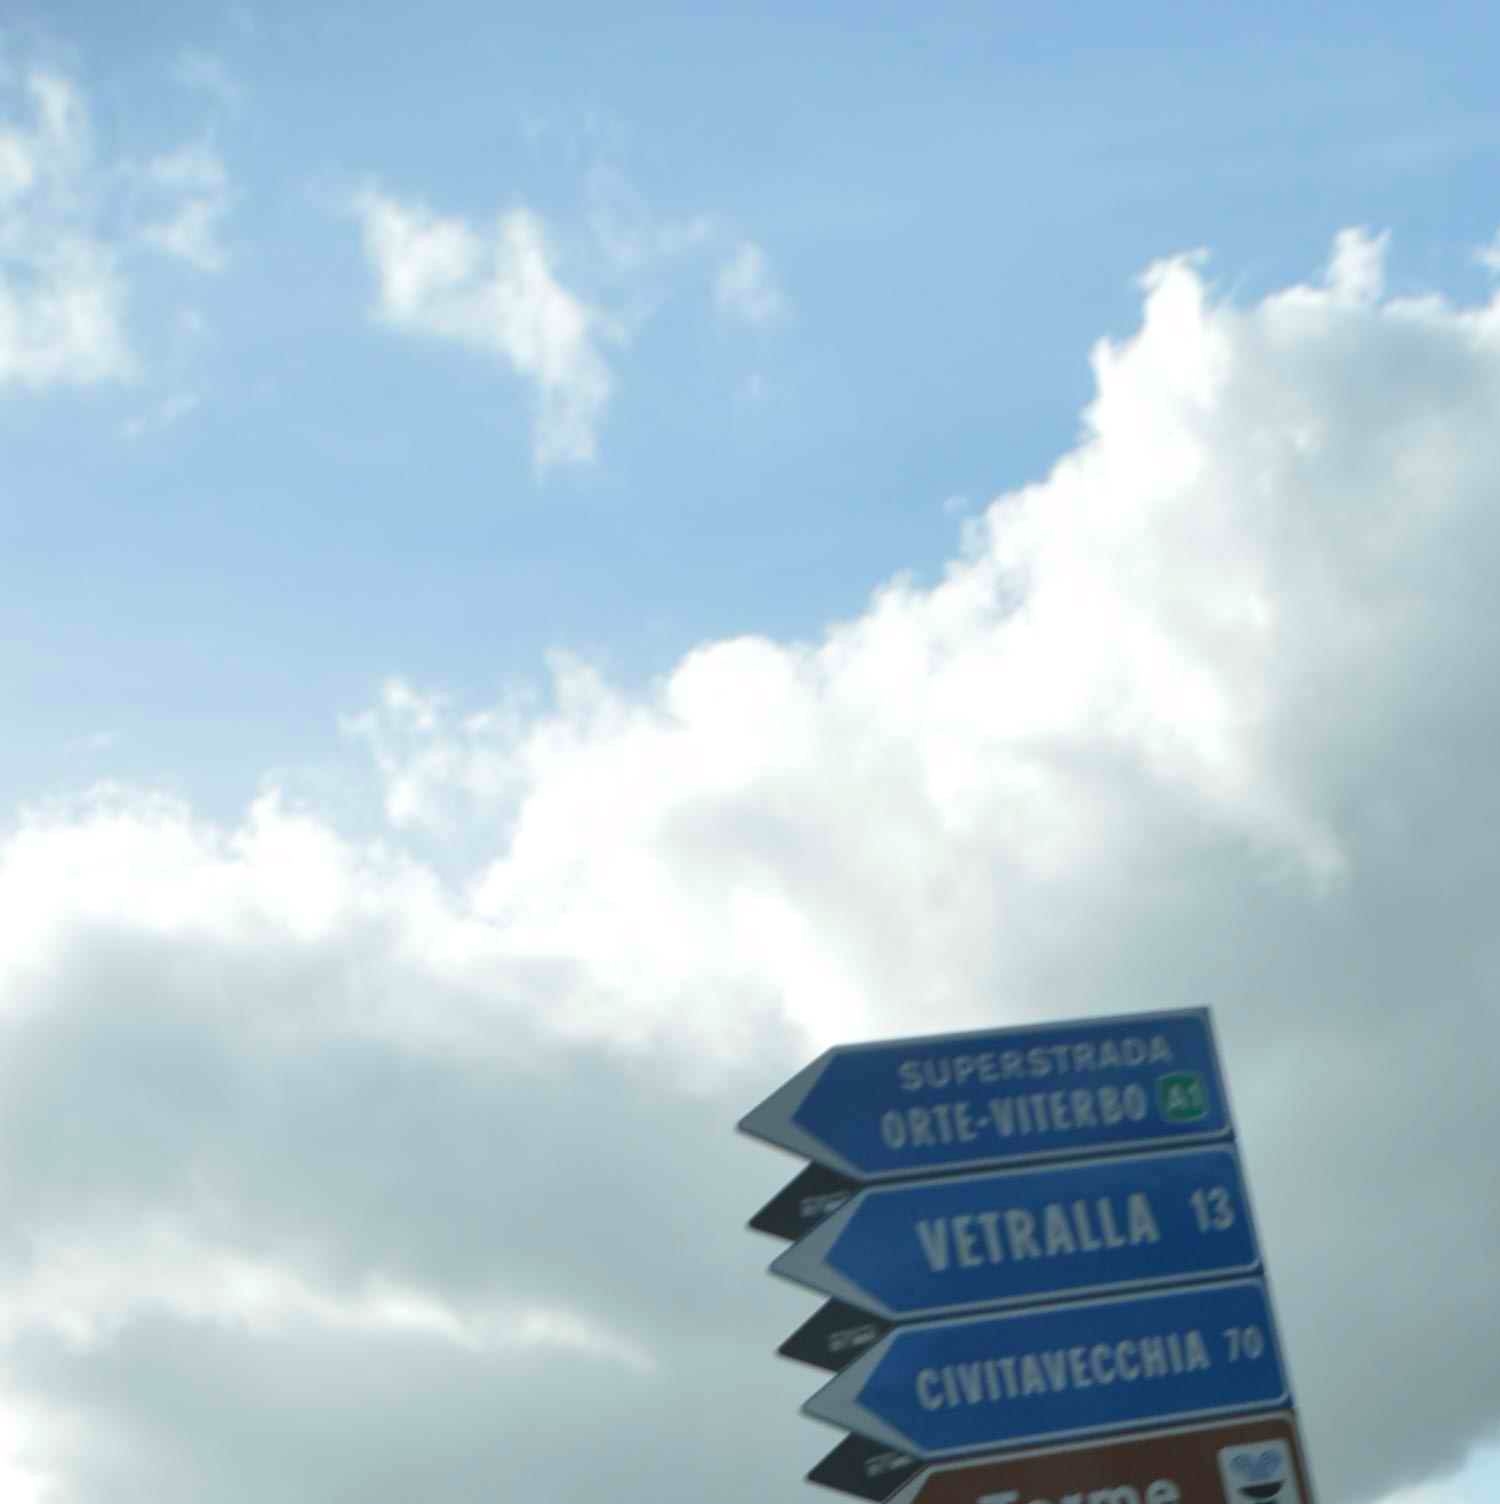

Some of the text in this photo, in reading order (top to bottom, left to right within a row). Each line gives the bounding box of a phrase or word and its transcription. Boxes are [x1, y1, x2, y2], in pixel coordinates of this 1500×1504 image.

[899, 1036, 1173, 1090] SUPERSTRADA
[881, 1085, 1147, 1148] ORTE-VITERBO
[916, 1193, 1160, 1272] VETRALLA
[1191, 1186, 1234, 1231] 13
[915, 1331, 1209, 1410] CIVITAVECCHIA
[1223, 1325, 1263, 1363] 70
